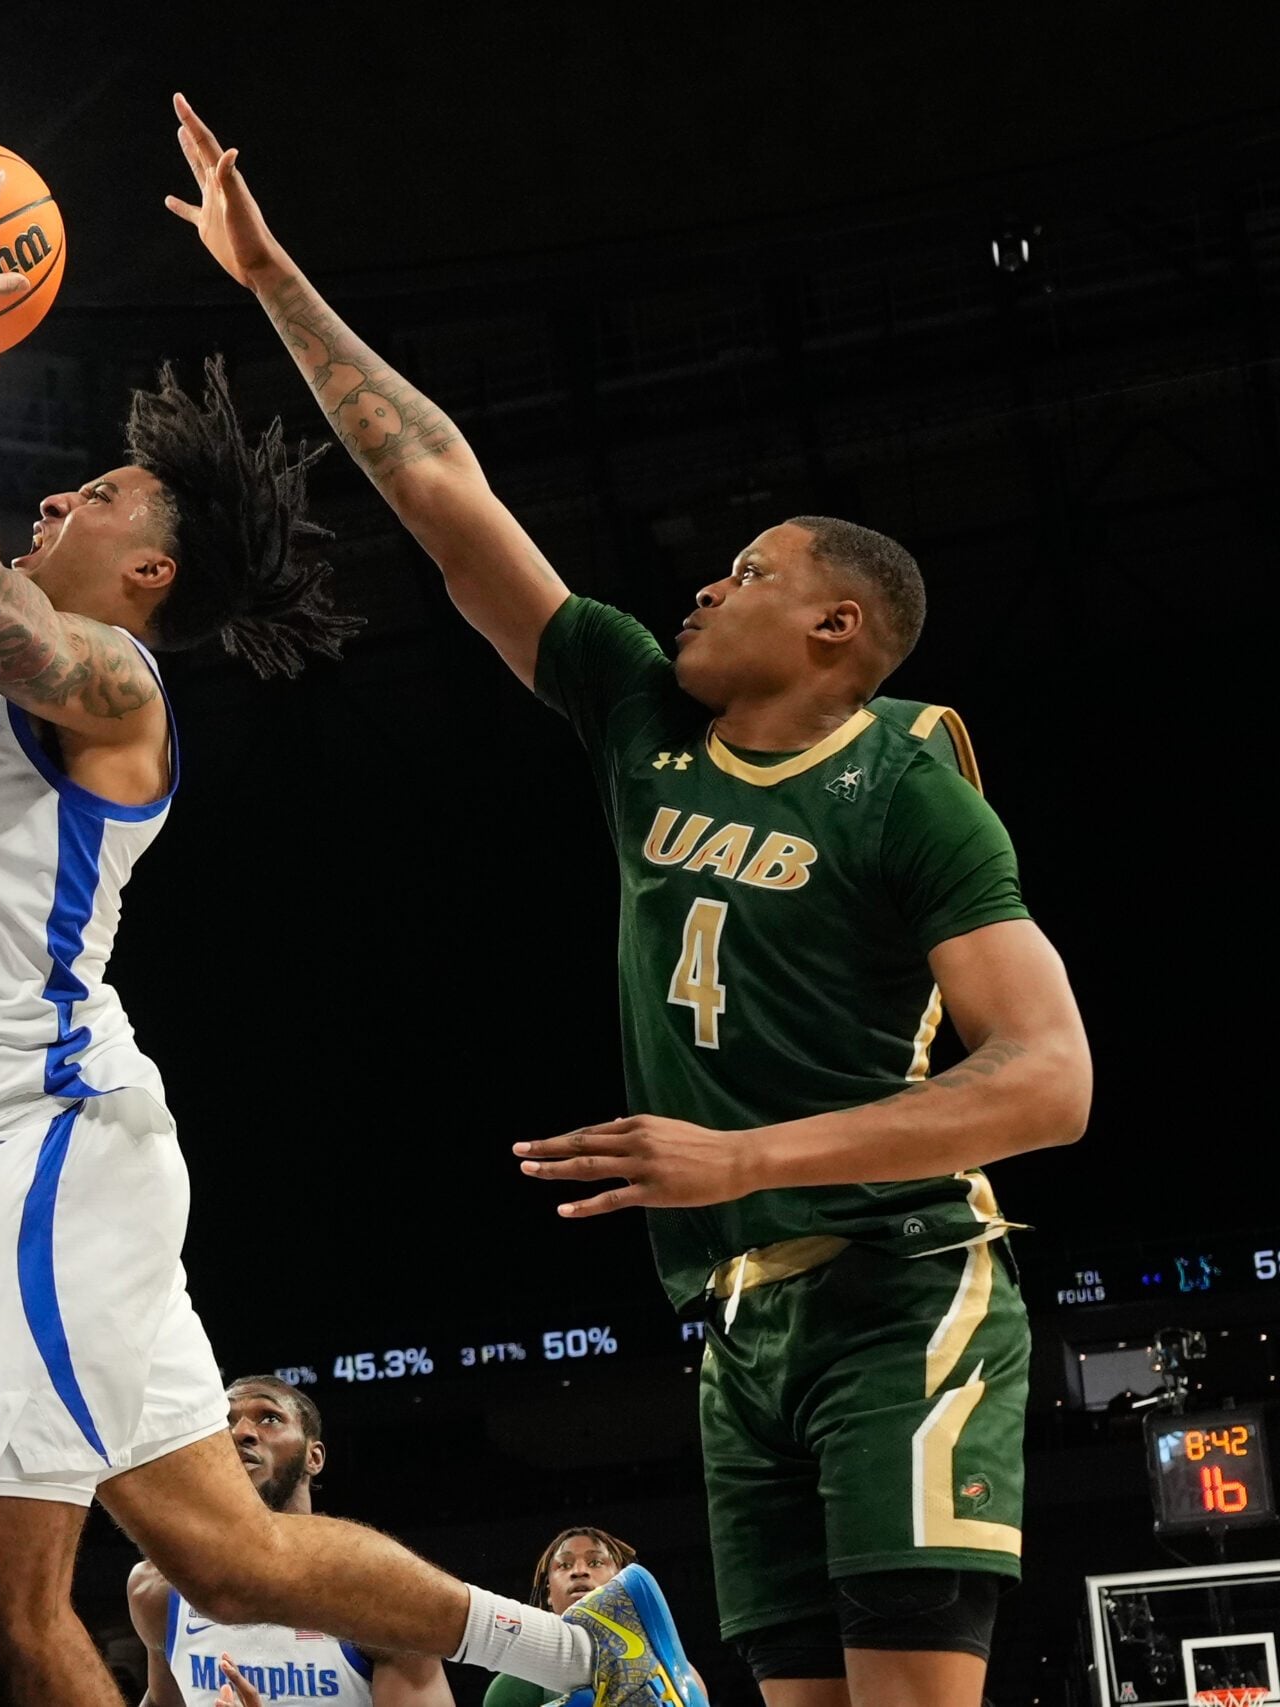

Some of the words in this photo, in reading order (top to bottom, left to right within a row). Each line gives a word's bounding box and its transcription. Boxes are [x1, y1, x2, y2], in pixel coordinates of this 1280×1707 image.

[644, 806, 818, 890] UAB
[667, 896, 728, 1050] 4
[1074, 1270, 1103, 1286] TOL
[1254, 1250, 1280, 1280] 5
[1057, 1286, 1106, 1304] FOULS
[460, 1347, 476, 1366] 3
[481, 1342, 526, 1364] PT%
[543, 1326, 618, 1360] 50%
[681, 1322, 706, 1341] FT
[333, 1347, 434, 1382] 45.3%
[1185, 1426, 1248, 1461] 8:42
